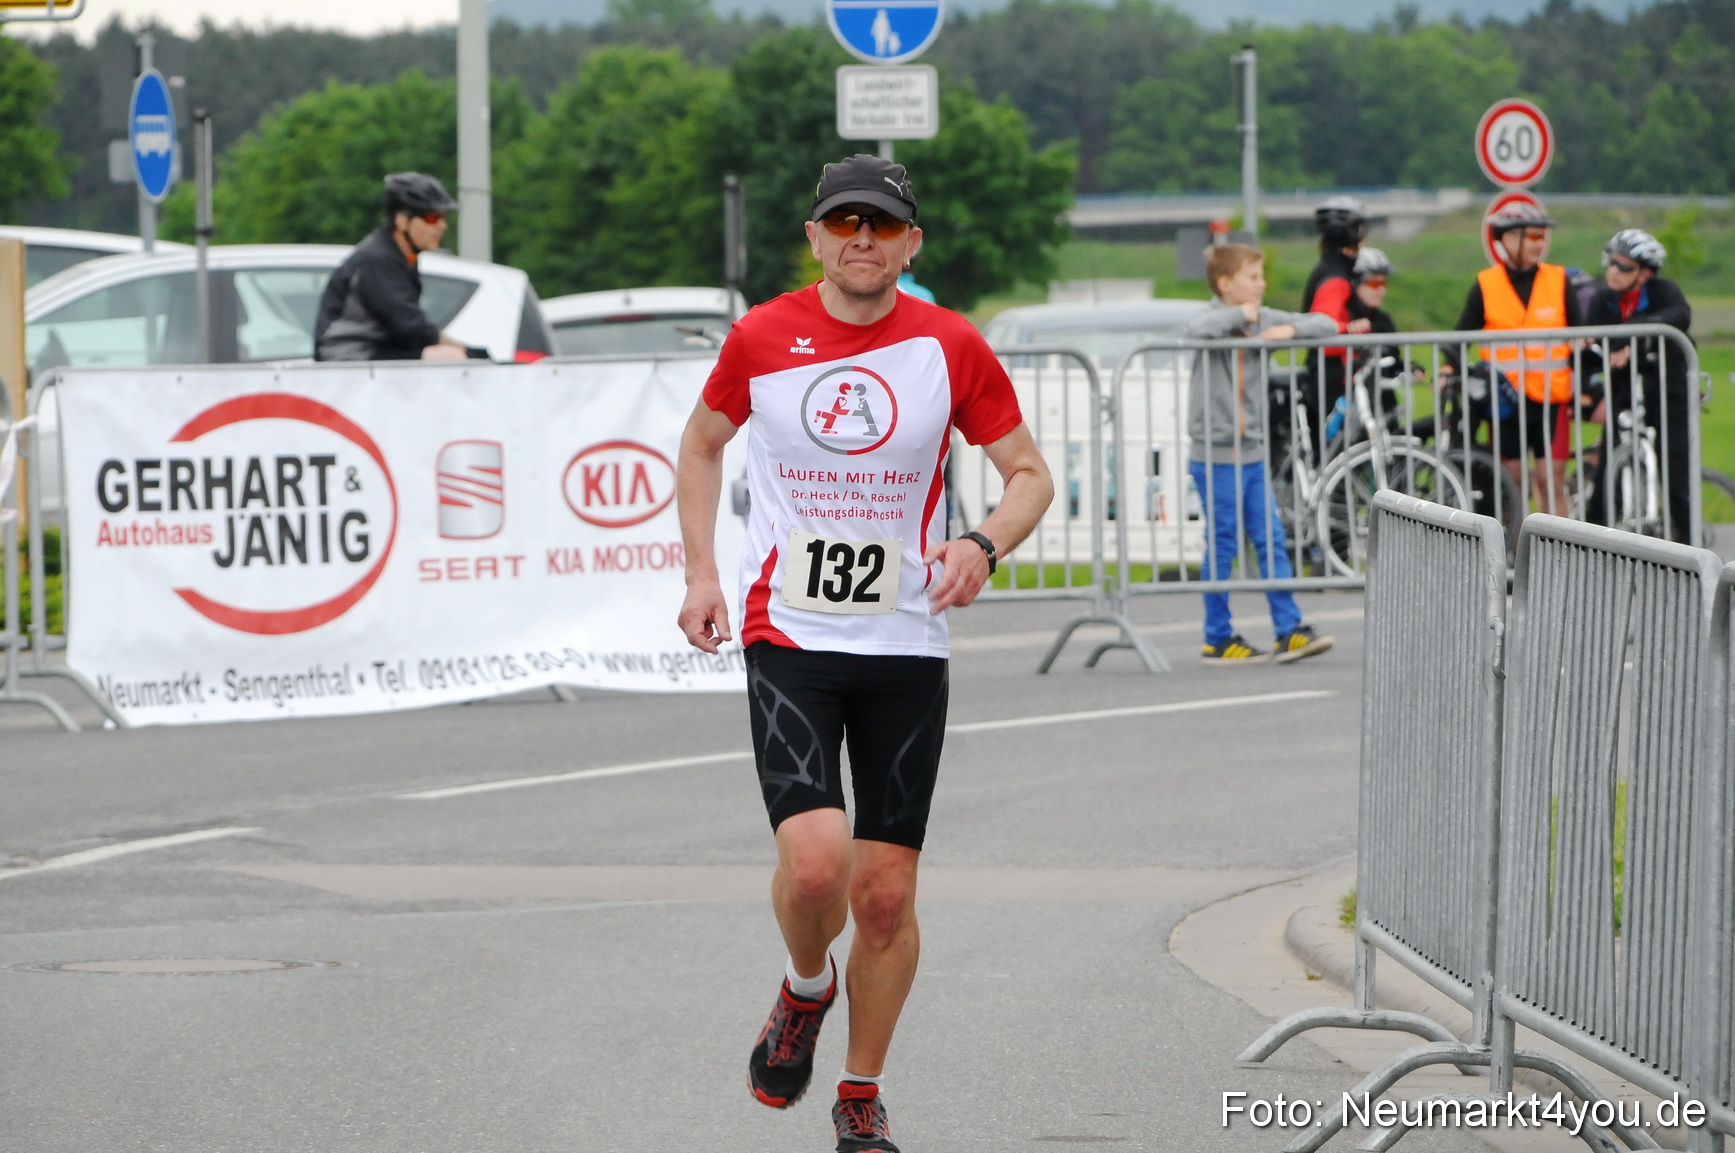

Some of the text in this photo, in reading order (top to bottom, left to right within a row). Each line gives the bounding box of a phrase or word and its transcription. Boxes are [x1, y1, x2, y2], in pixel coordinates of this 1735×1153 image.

[1495, 125, 1534, 161] 60
[97, 454, 361, 514] GERHART &
[580, 461, 656, 508] KIA
[791, 489, 807, 499] Dr.
[810, 491, 839, 500] Heck
[851, 491, 867, 501] Dr.
[871, 492, 906, 503] Röschl
[795, 505, 904, 520] Leistungsdiagnostik
[97, 519, 213, 547] Autohaus
[213, 510, 370, 568] JÄNIG
[418, 556, 526, 582] SEAT
[546, 548, 585, 574] KIA
[806, 538, 885, 602] 132
[98, 671, 205, 708] Neumarkt
[223, 665, 353, 708] Sengenthal
[372, 660, 415, 694] Tel.
